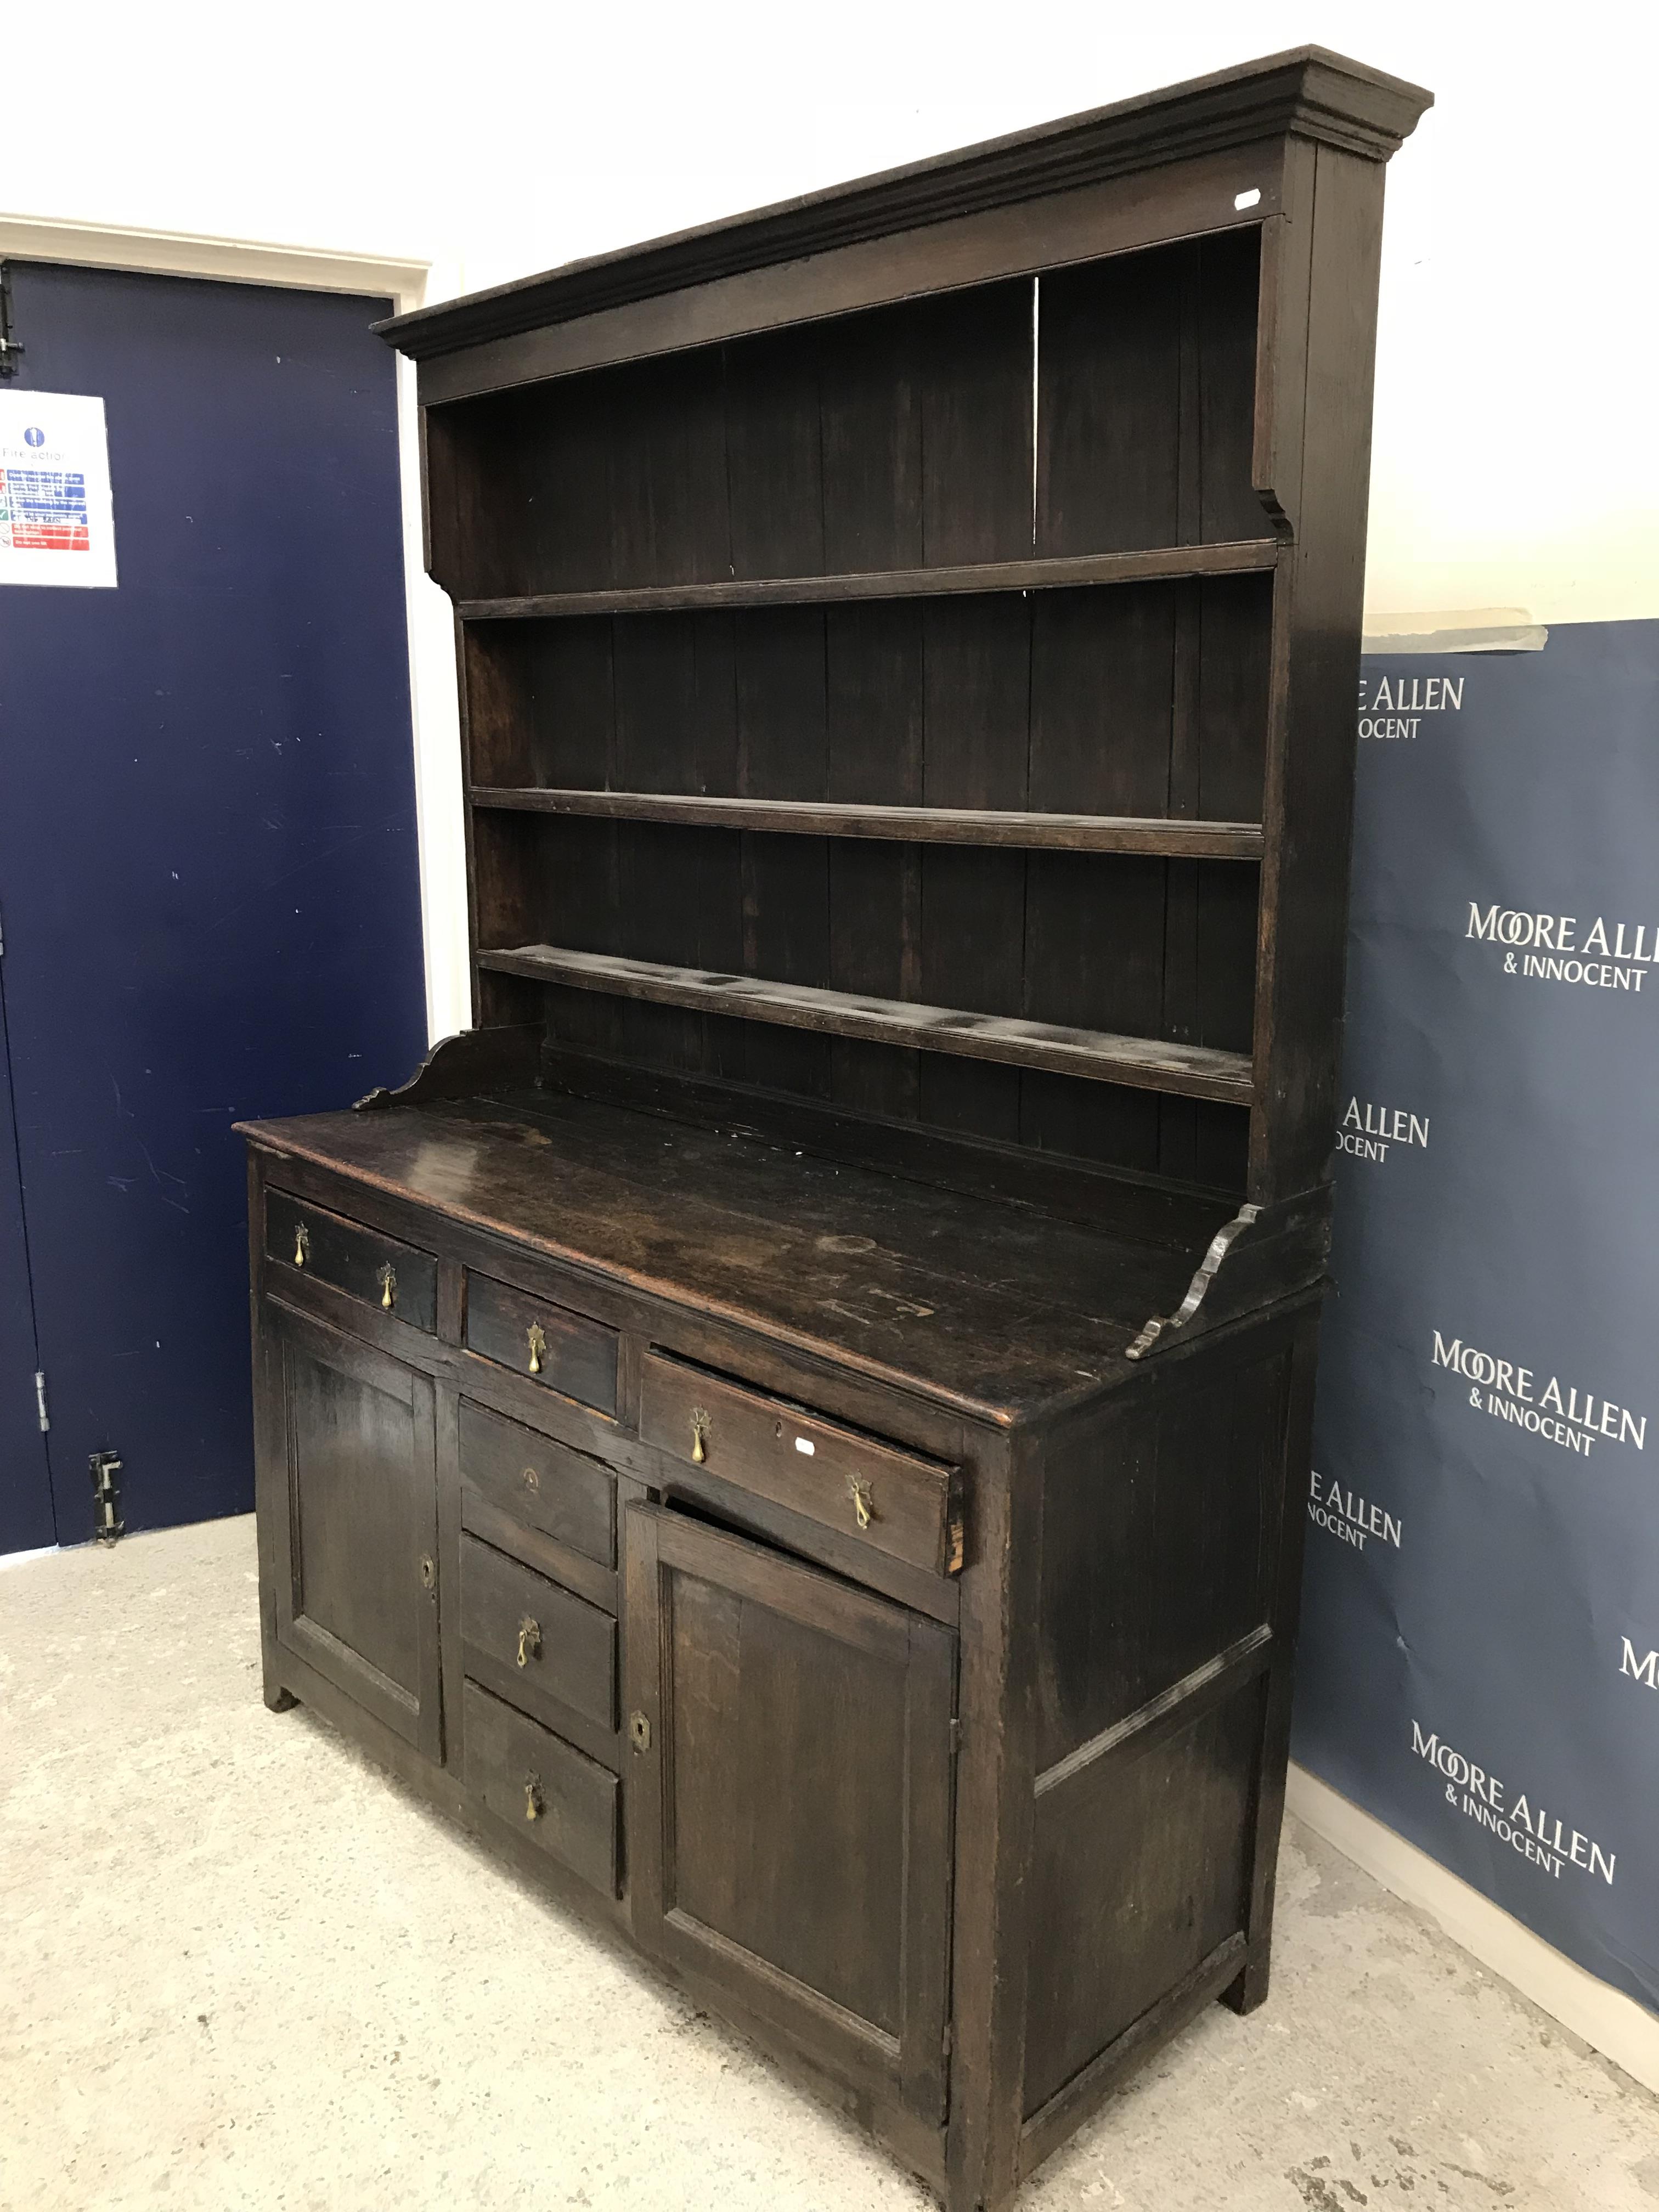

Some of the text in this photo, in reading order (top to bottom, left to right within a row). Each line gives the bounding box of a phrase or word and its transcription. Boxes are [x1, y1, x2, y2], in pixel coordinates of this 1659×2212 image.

[1371, 675, 1465, 710] ALLEN
[1358, 718, 1421, 738] OCENT
[1465, 901, 1576, 957] MOORE
[1503, 952, 1648, 992] & INNOCENT
[1342, 1096, 1430, 1148] ALLEN
[1431, 1329, 1647, 1450] MOORE ALLEN
[1469, 1386, 1596, 1457] & INNOCENT
[1325, 1480, 1402, 1548] ALLEN
[1618, 1635, 1659, 1690] M
[1410, 1719, 1616, 1885] MOORE ALLEN
[1445, 1783, 1565, 1879] & INNOCENT
